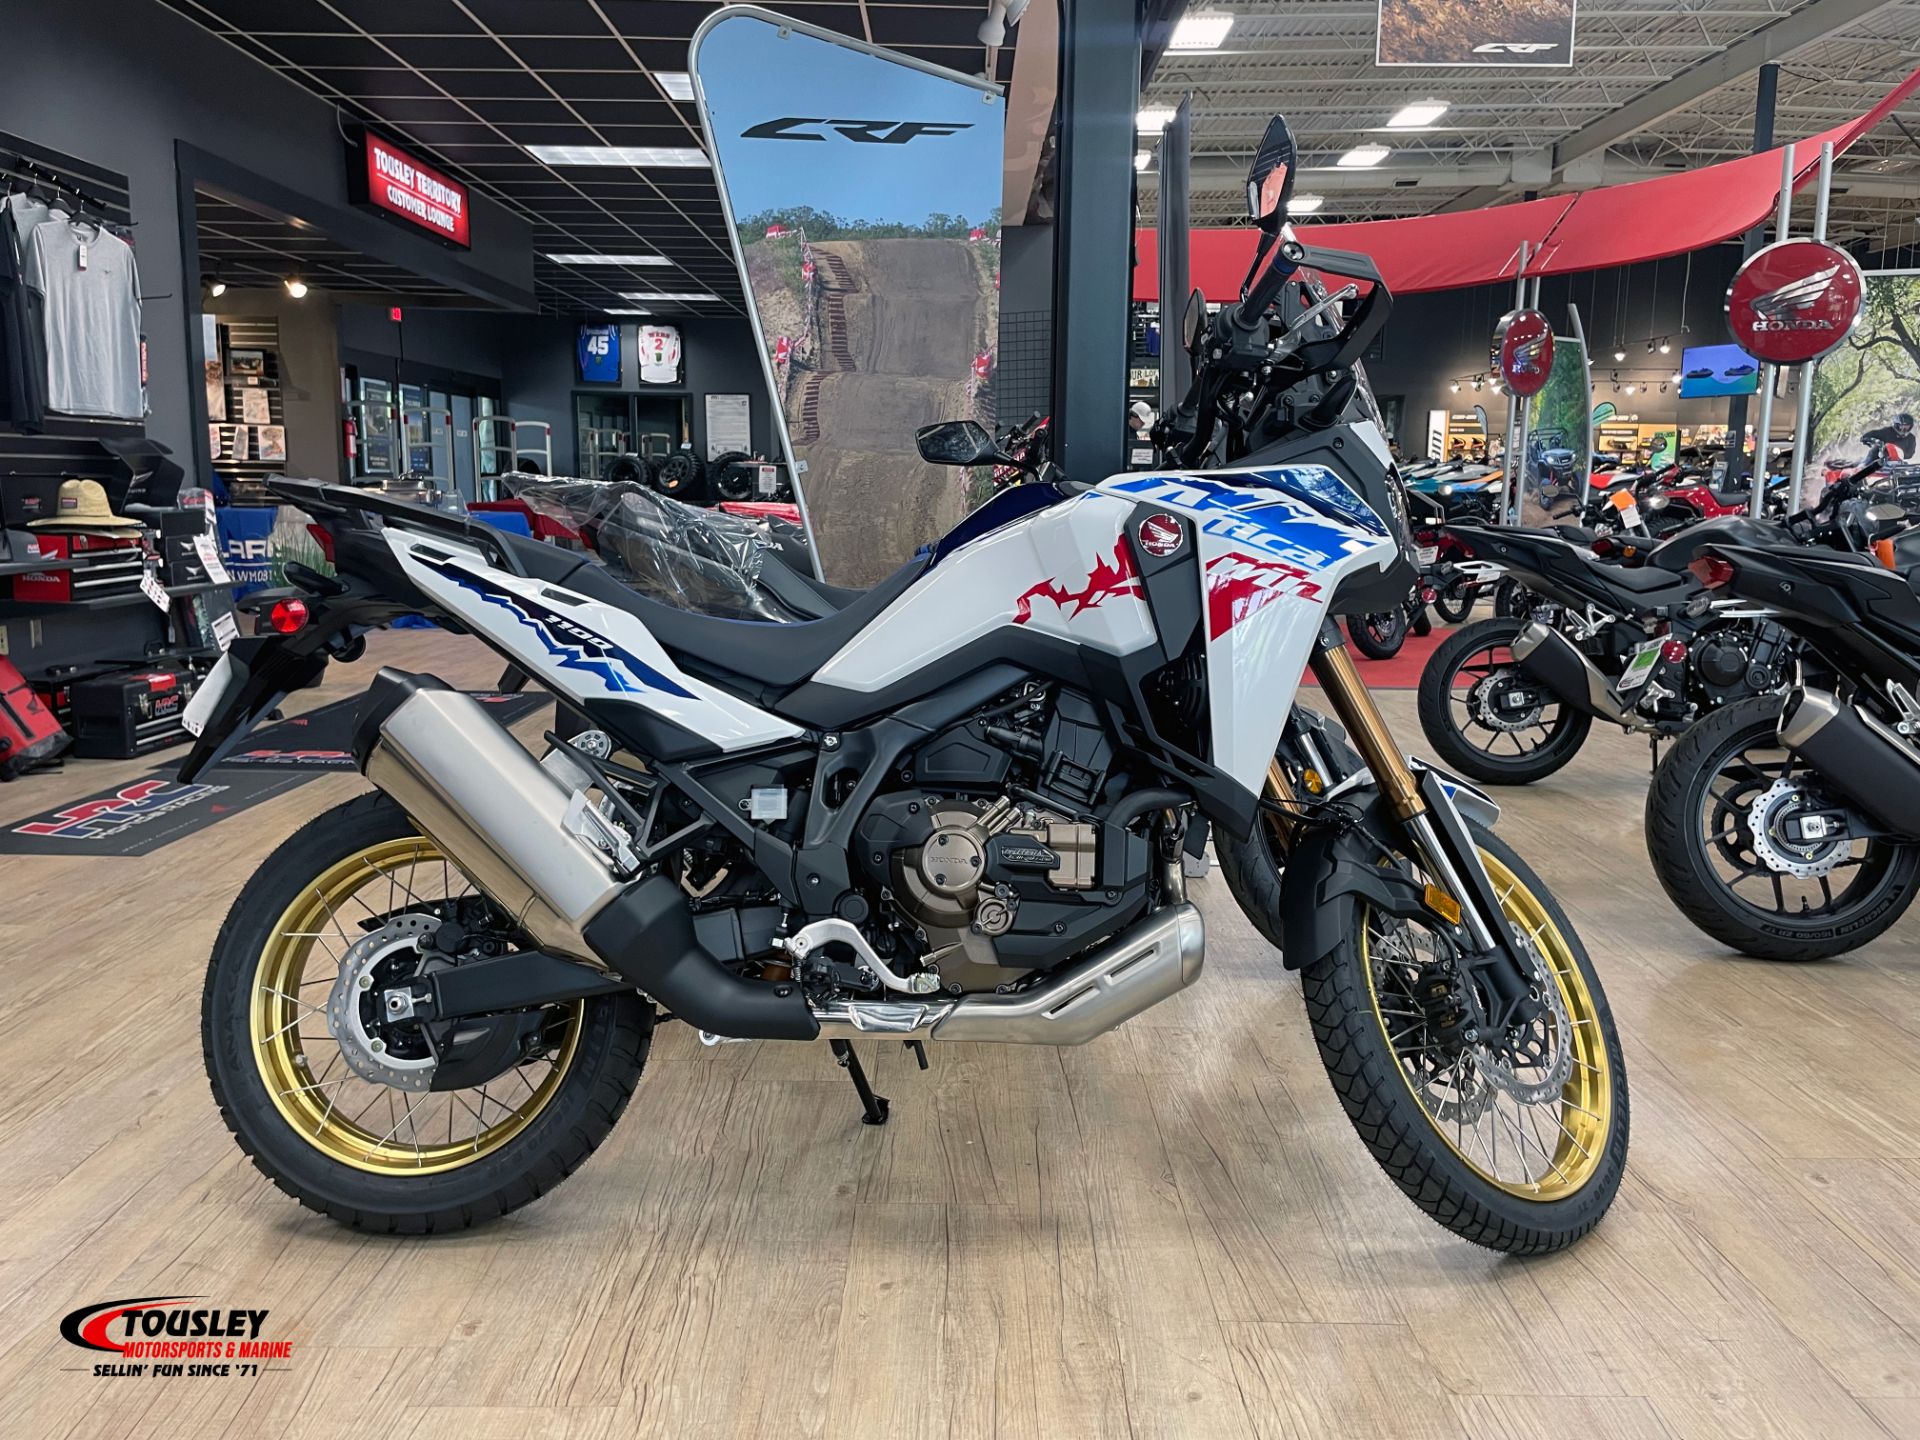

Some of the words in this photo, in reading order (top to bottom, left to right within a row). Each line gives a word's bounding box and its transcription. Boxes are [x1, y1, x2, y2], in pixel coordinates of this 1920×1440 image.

[740, 117, 976, 144] CRF
[374, 147, 415, 189] TOUSLEY
[416, 171, 461, 213] TERRITORY
[387, 185, 427, 220] CUSTOMER
[427, 204, 454, 232] LOUNGE
[1752, 320, 1834, 330] HONDA
[587, 335, 609, 355] 45
[655, 338, 664, 350] 2
[545, 614, 614, 650] 1100
[11, 780, 213, 839] HRC
[930, 856, 968, 864] HONDA
[1840, 900, 1889, 934] MICHELIN
[1610, 1041, 1627, 1160] MICHELIN
